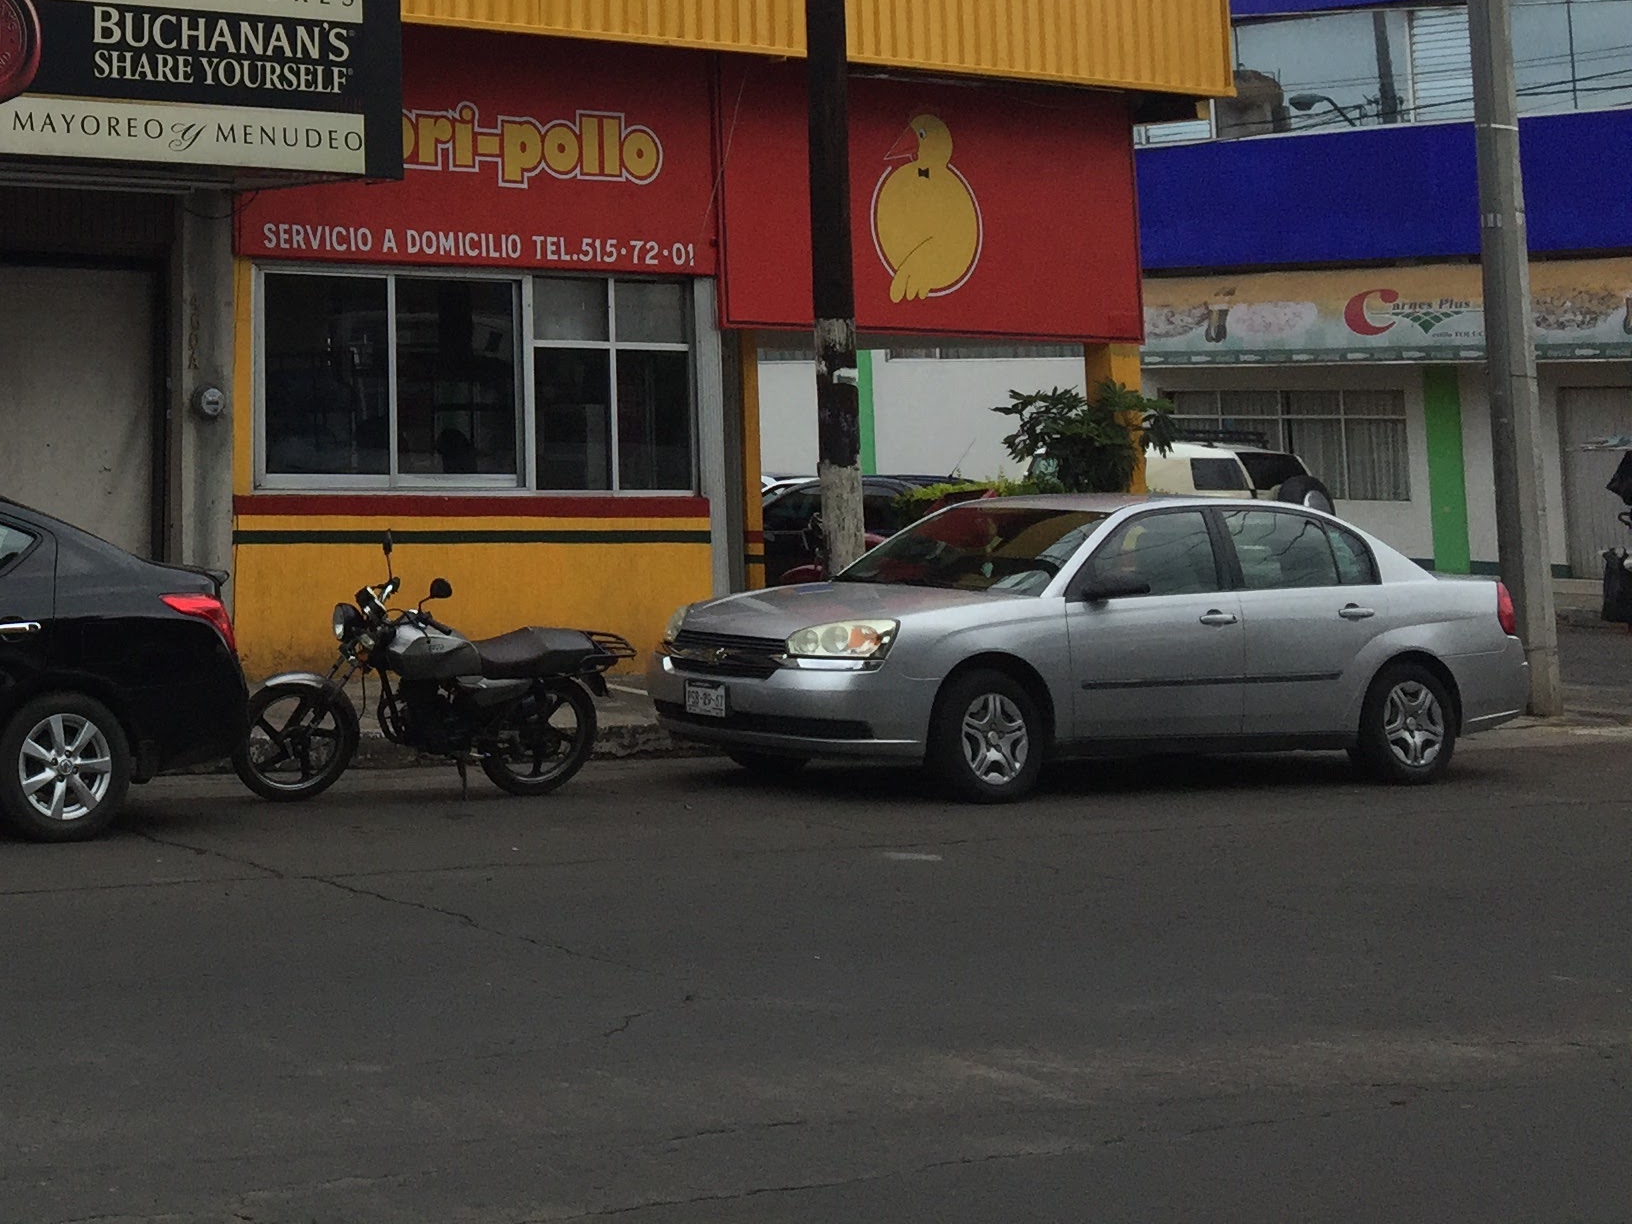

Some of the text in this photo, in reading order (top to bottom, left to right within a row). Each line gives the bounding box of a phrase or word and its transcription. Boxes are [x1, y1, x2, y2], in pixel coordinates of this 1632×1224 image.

[93, 6, 350, 62] BUCHANAN'S
[94, 51, 348, 94] SHARE YOURSELF
[12, 111, 164, 140] MAYOREO
[215, 123, 364, 152] MENUDEO
[263, 223, 373, 252] SERVICIO
[382, 228, 398, 254] A
[406, 229, 522, 259] DOMICILIO
[1343, 288, 1472, 336] Carnes Plus
